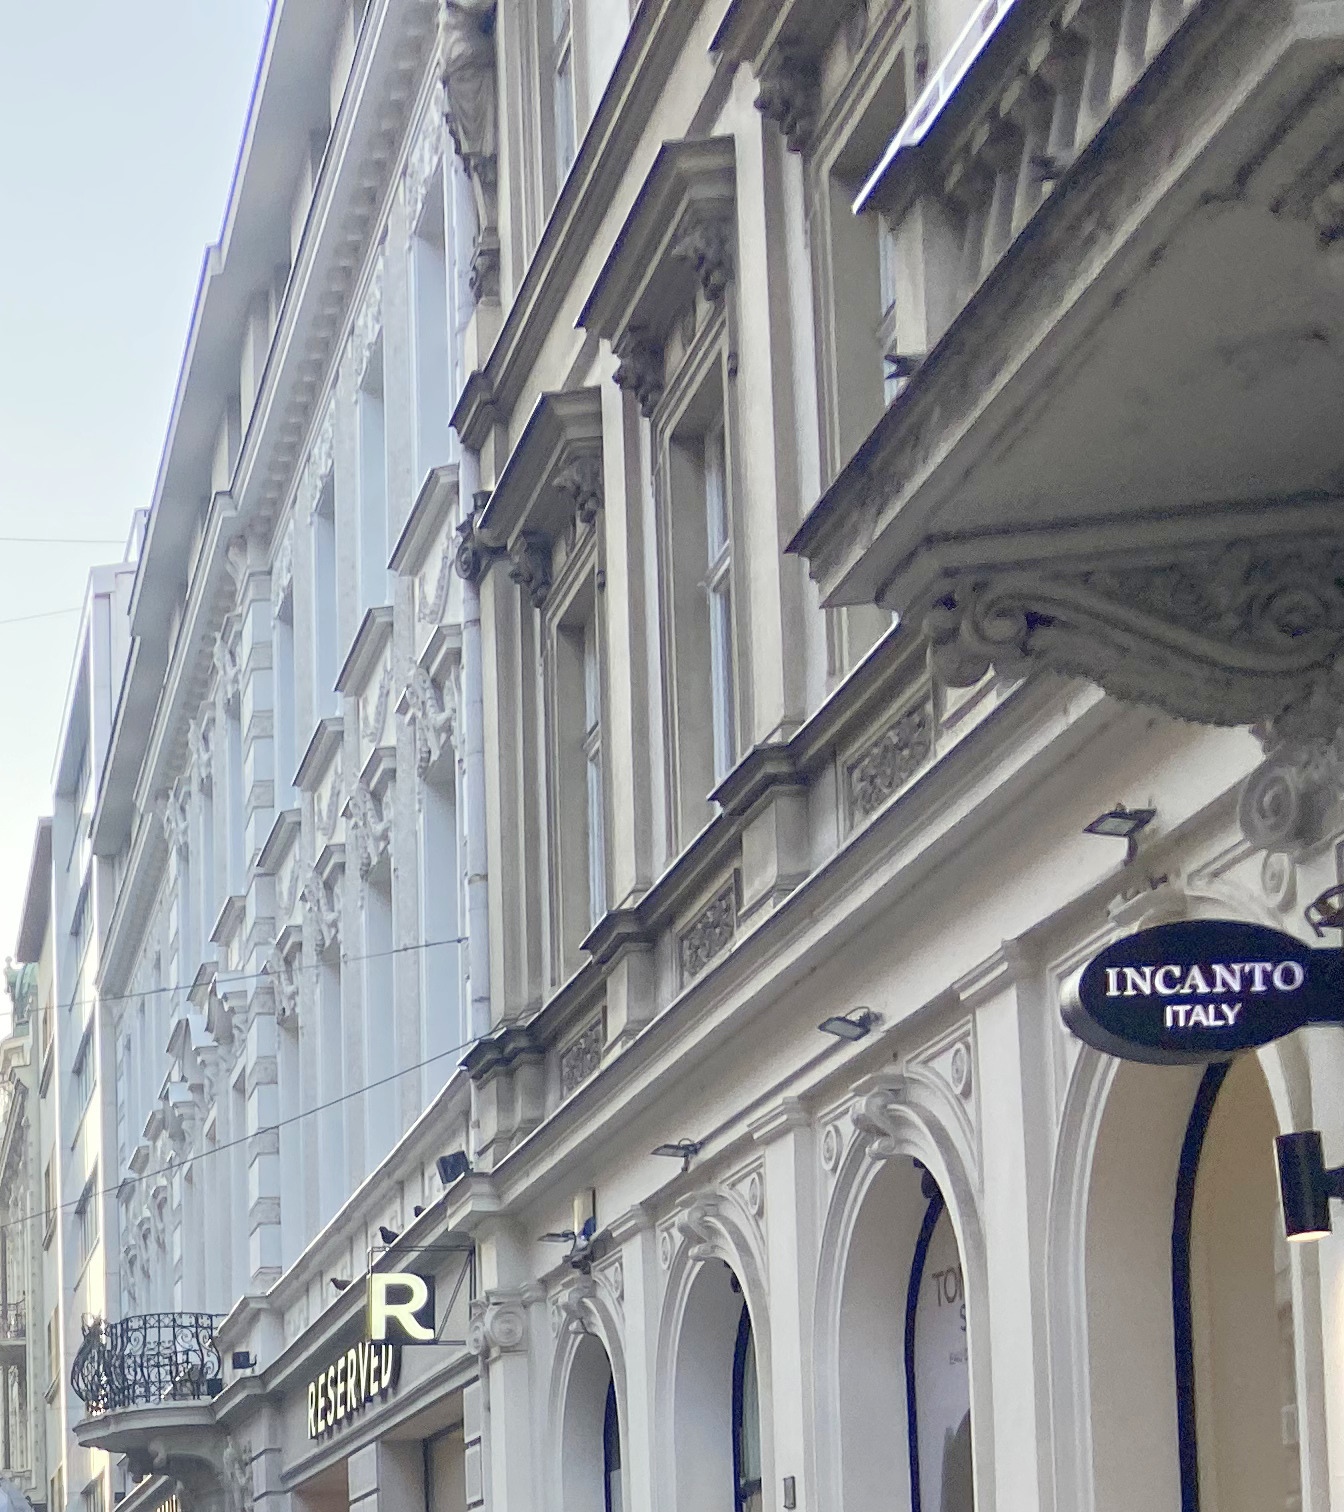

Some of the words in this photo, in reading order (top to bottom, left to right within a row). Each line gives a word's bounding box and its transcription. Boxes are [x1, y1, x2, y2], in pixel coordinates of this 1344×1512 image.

[1105, 960, 1305, 997] INCANTO
[1165, 1002, 1243, 1028] ITALY
[366, 1272, 435, 1341] R
[307, 1341, 393, 1440] RESERVED
